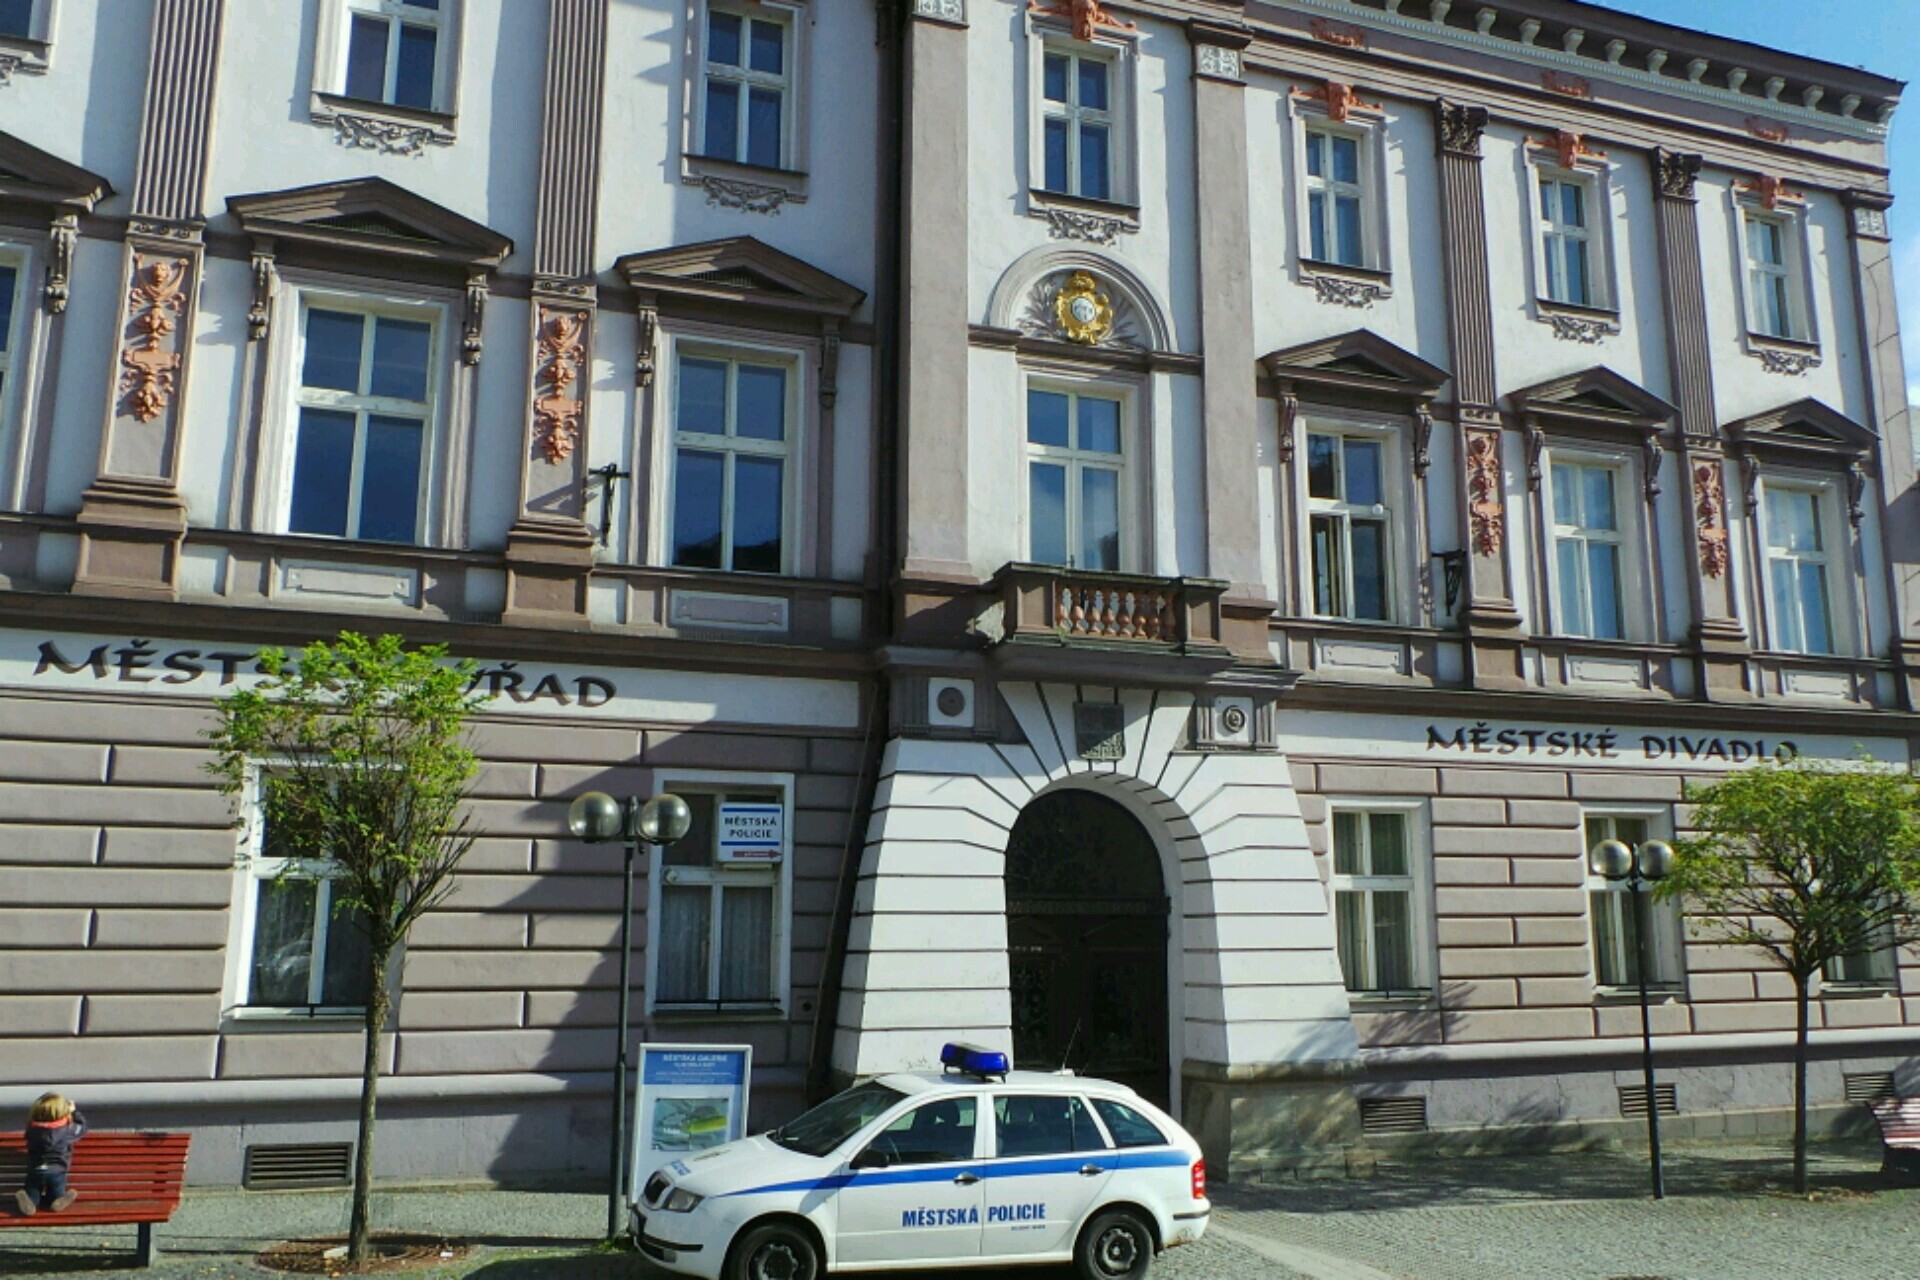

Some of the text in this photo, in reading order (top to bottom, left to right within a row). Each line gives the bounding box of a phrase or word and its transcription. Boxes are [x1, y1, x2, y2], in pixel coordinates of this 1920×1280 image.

[33, 639, 617, 708] MĚSTS ŘAD
[1425, 721, 1799, 766] MĚSTSKÉ DIVADLO
[724, 815, 777, 826] MĚSTSKÁ
[730, 829, 772, 838] POLICIE
[902, 1202, 1046, 1227] MĚSTSKÁ POLICIE
